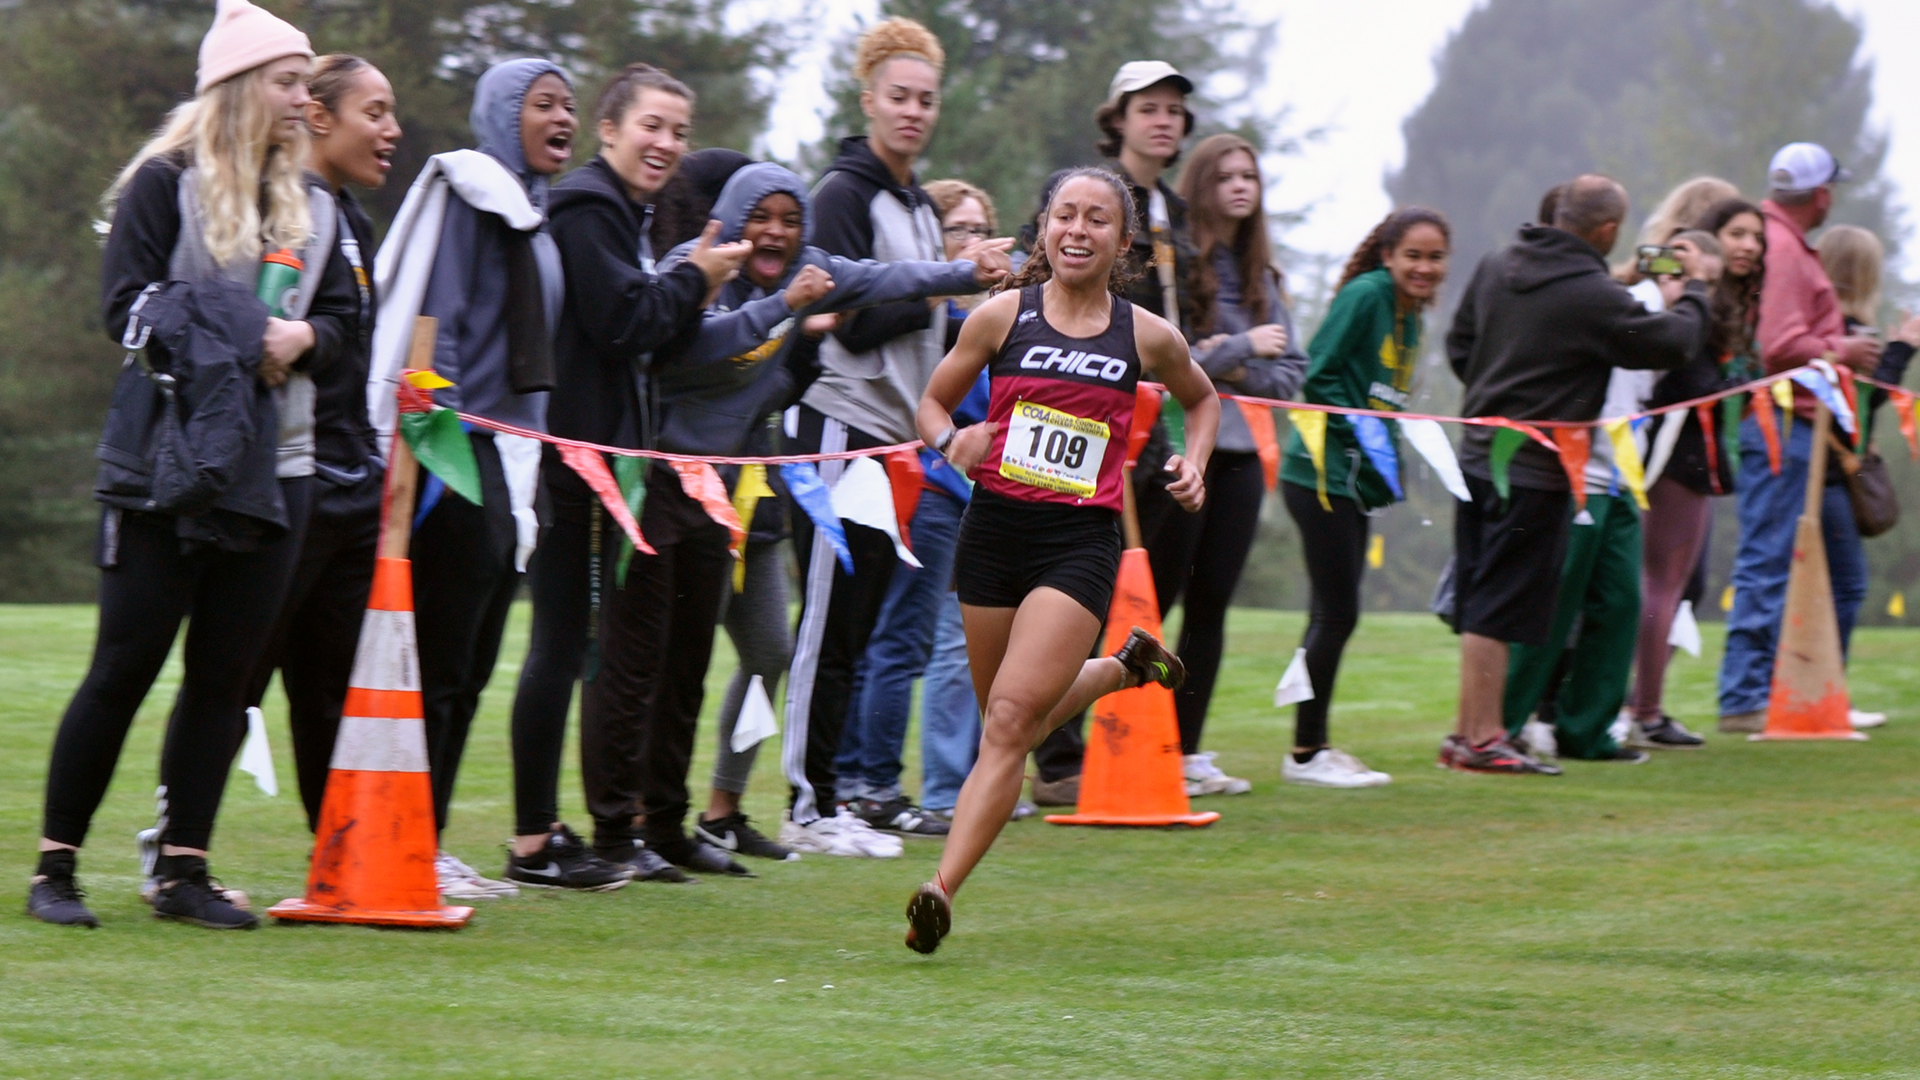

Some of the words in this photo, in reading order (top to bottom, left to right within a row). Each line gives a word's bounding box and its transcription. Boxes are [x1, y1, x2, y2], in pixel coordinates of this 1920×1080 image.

[1020, 345, 1128, 382] CHICO
[1050, 417, 1105, 437] CHAMPIONSHIPS
[1051, 412, 1074, 422] CROSS
[1029, 425, 1088, 469] 109
